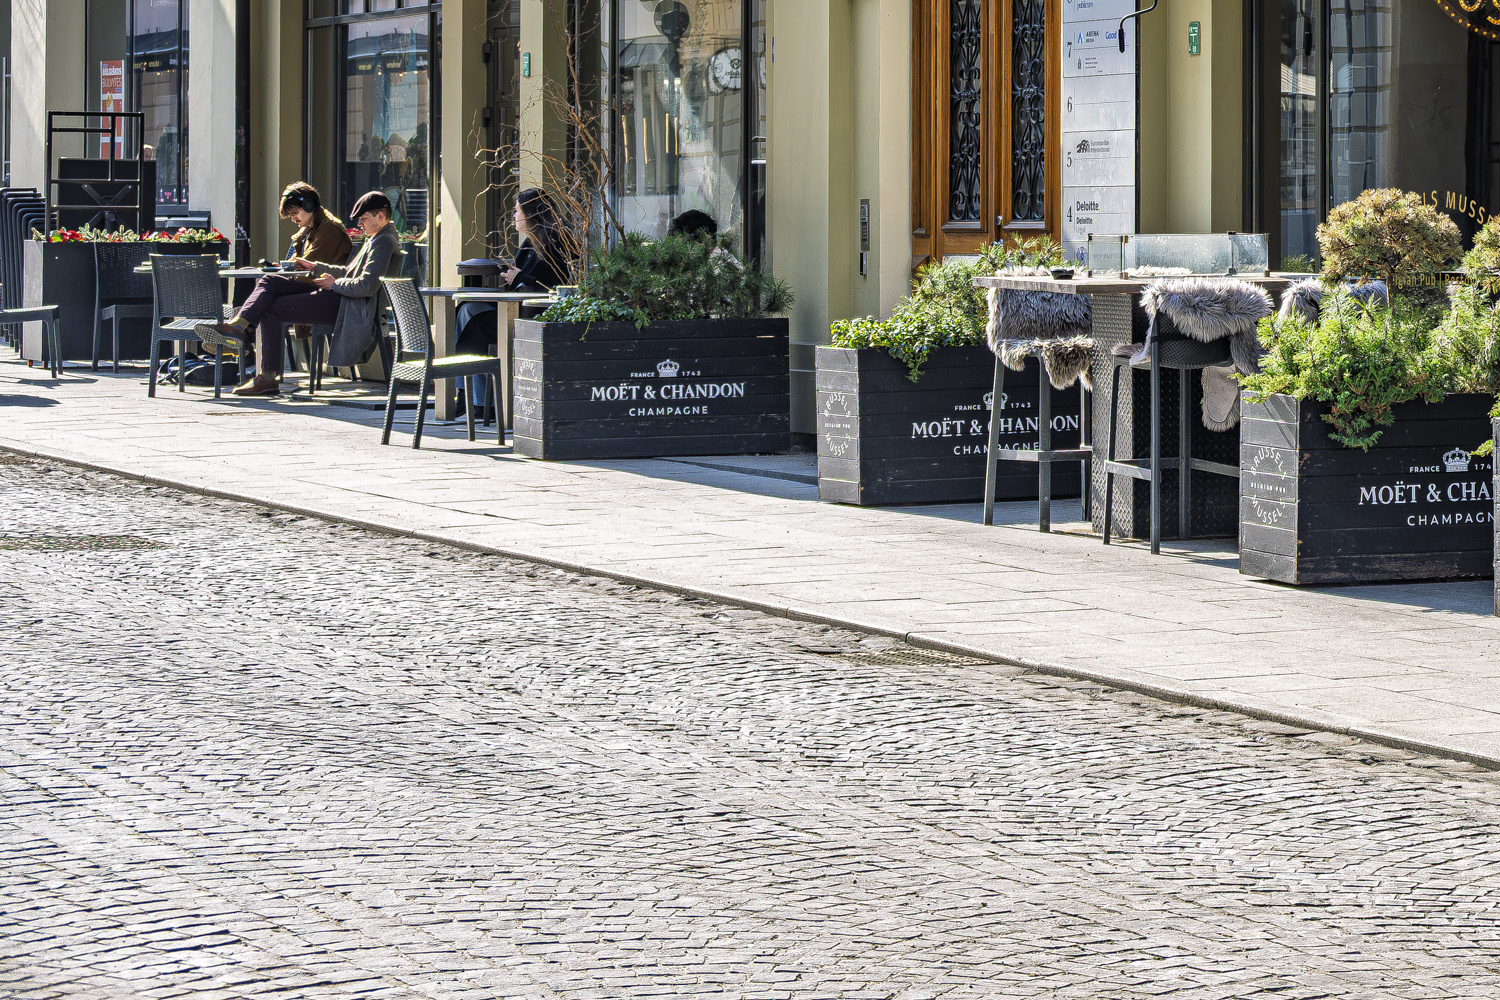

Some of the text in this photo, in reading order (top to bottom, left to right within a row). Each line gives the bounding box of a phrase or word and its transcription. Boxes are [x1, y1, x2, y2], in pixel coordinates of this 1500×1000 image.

[1086, 30, 1099, 38] ARENA
[1105, 31, 1117, 40] Good
[1067, 41, 1072, 58] 7
[1067, 96, 1073, 114] 6
[1066, 151, 1073, 168] 5
[1066, 205, 1073, 222] 4
[1420, 273, 1436, 286] Pub
[1444, 274, 1475, 286] Resto
[590, 383, 745, 402] MOËT & CHANDON
[629, 406, 708, 417] CHAMPAGNE
[823, 392, 851, 418] BRUSSELS
[911, 415, 1080, 439] MOËT & HANON
[825, 433, 851, 457] MUSSELS
[1250, 447, 1287, 481] BRUSSELS
[1409, 465, 1440, 473] FRANCE
[1358, 481, 1494, 506] MOËT & CHA
[1251, 494, 1286, 525] MUSSELS
